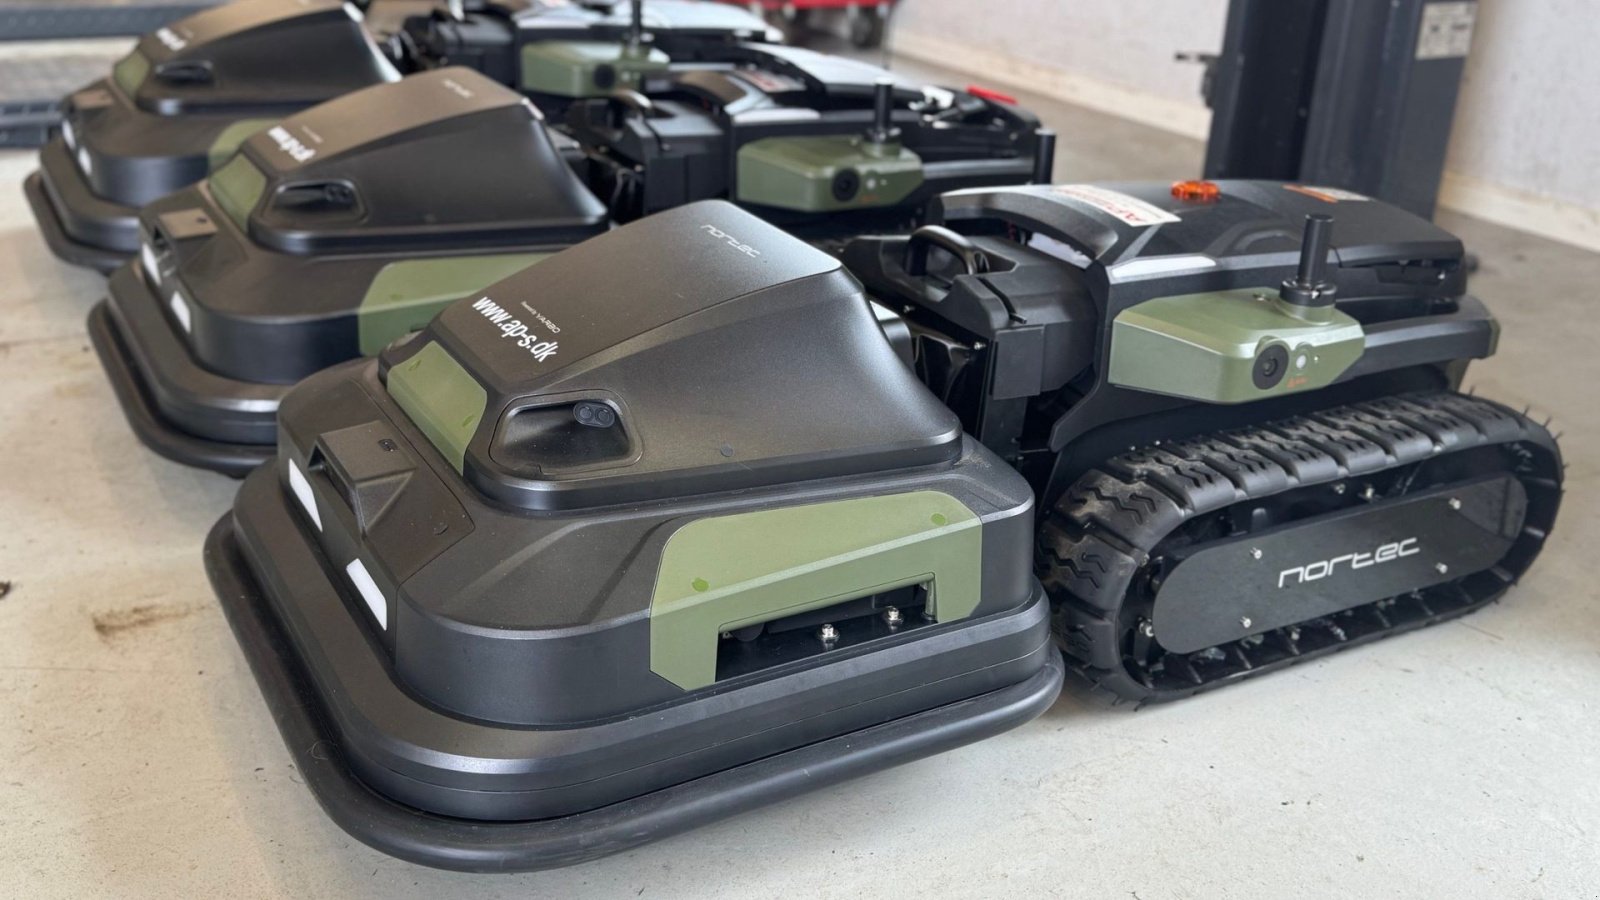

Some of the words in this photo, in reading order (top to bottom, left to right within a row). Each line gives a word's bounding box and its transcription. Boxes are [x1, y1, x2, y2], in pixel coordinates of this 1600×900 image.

[700, 224, 761, 258] nortec
[472, 296, 558, 362] www.ap-s.dk
[1278, 537, 1420, 588] nortec
